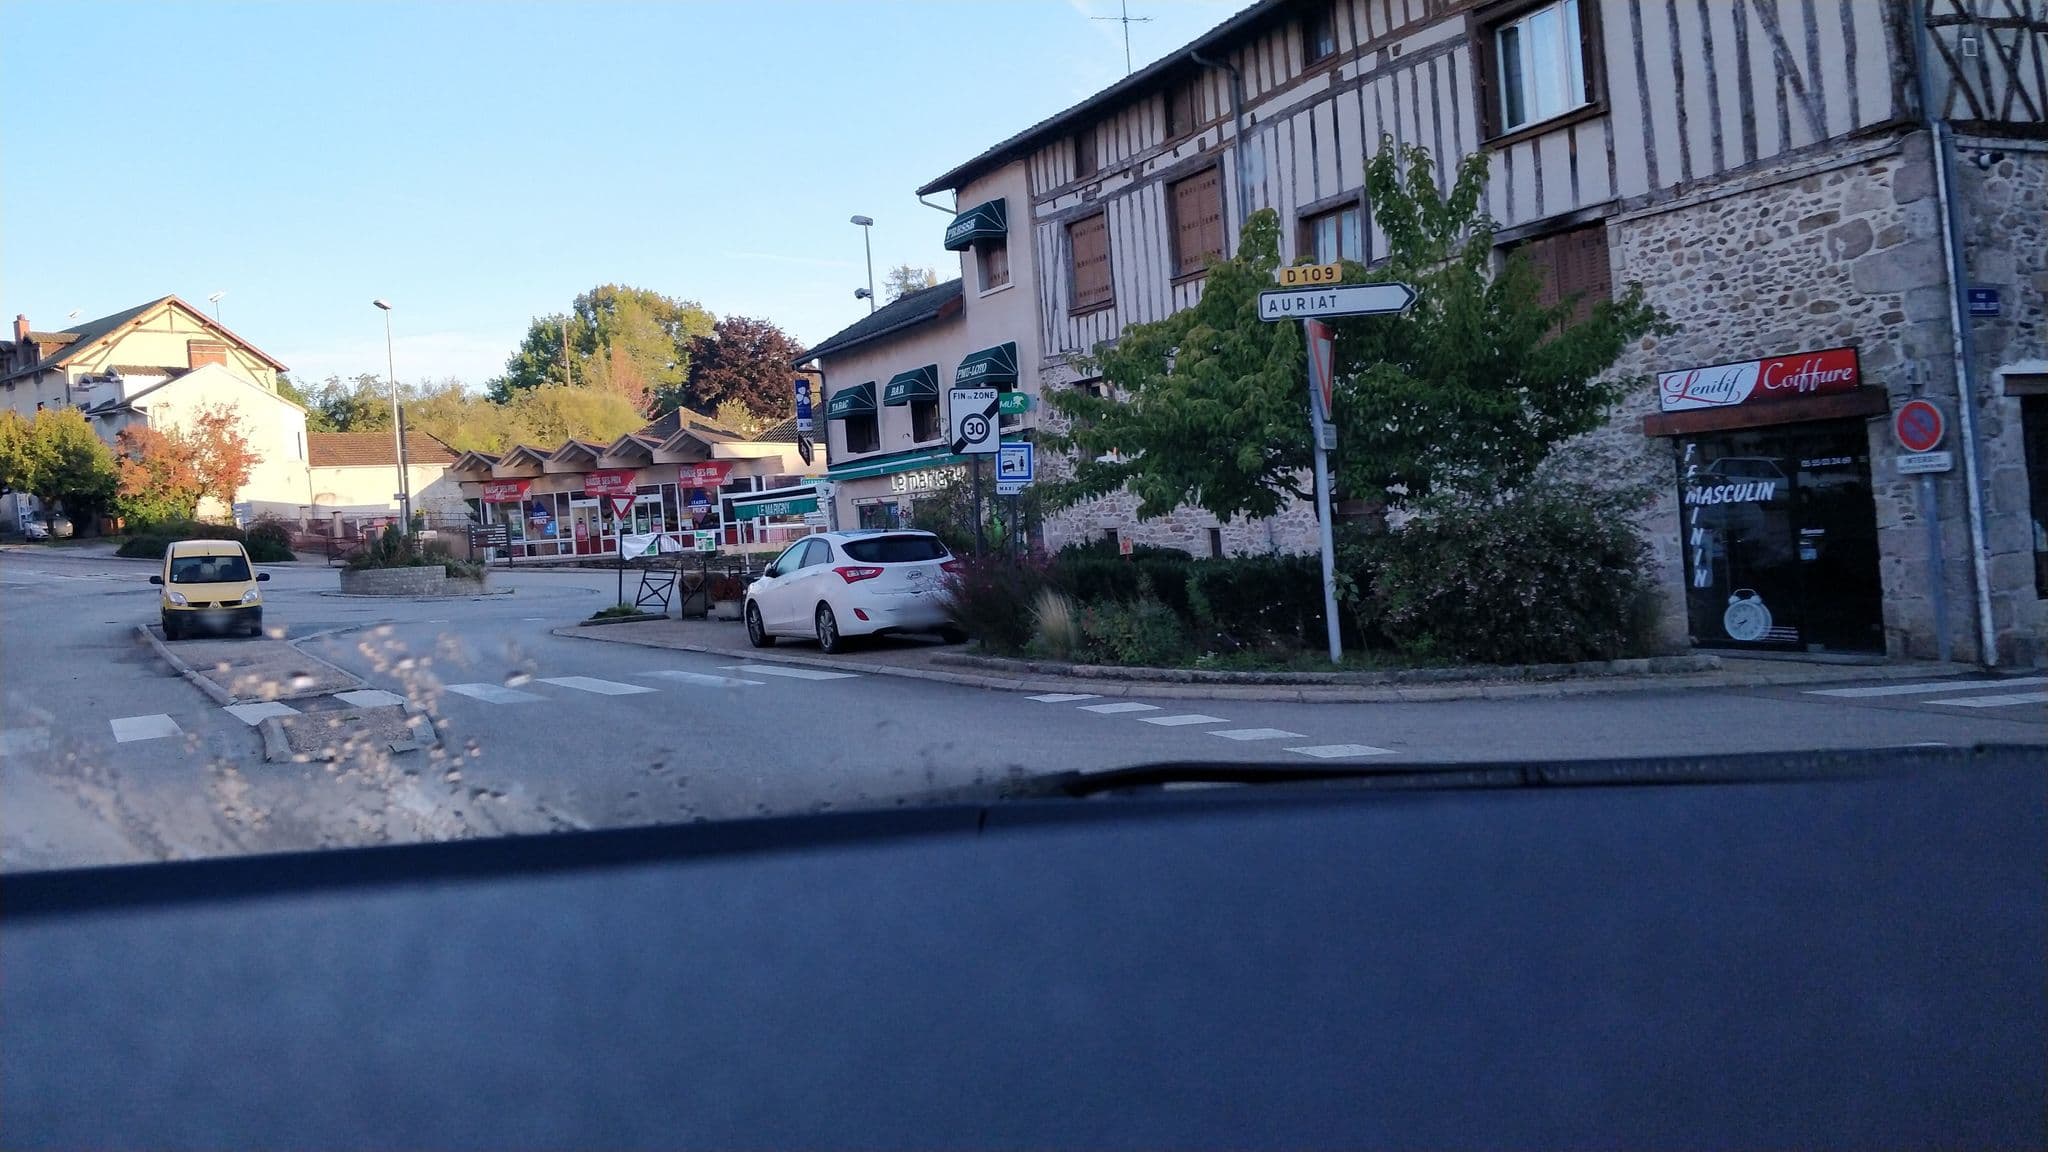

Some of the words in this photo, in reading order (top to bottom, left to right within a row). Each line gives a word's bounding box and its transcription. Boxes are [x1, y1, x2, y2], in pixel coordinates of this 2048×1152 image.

[1268, 295, 1337, 313] AURIAT
[1663, 368, 1758, 404] Lenitif
[1763, 358, 1852, 392] Coiffure
[890, 385, 905, 396] BAR
[953, 392, 966, 400] FIN
[973, 391, 995, 399] ZONE
[831, 400, 850, 413] TABAC
[967, 422, 984, 435] 30
[1685, 482, 1776, 505] MASCULIN
